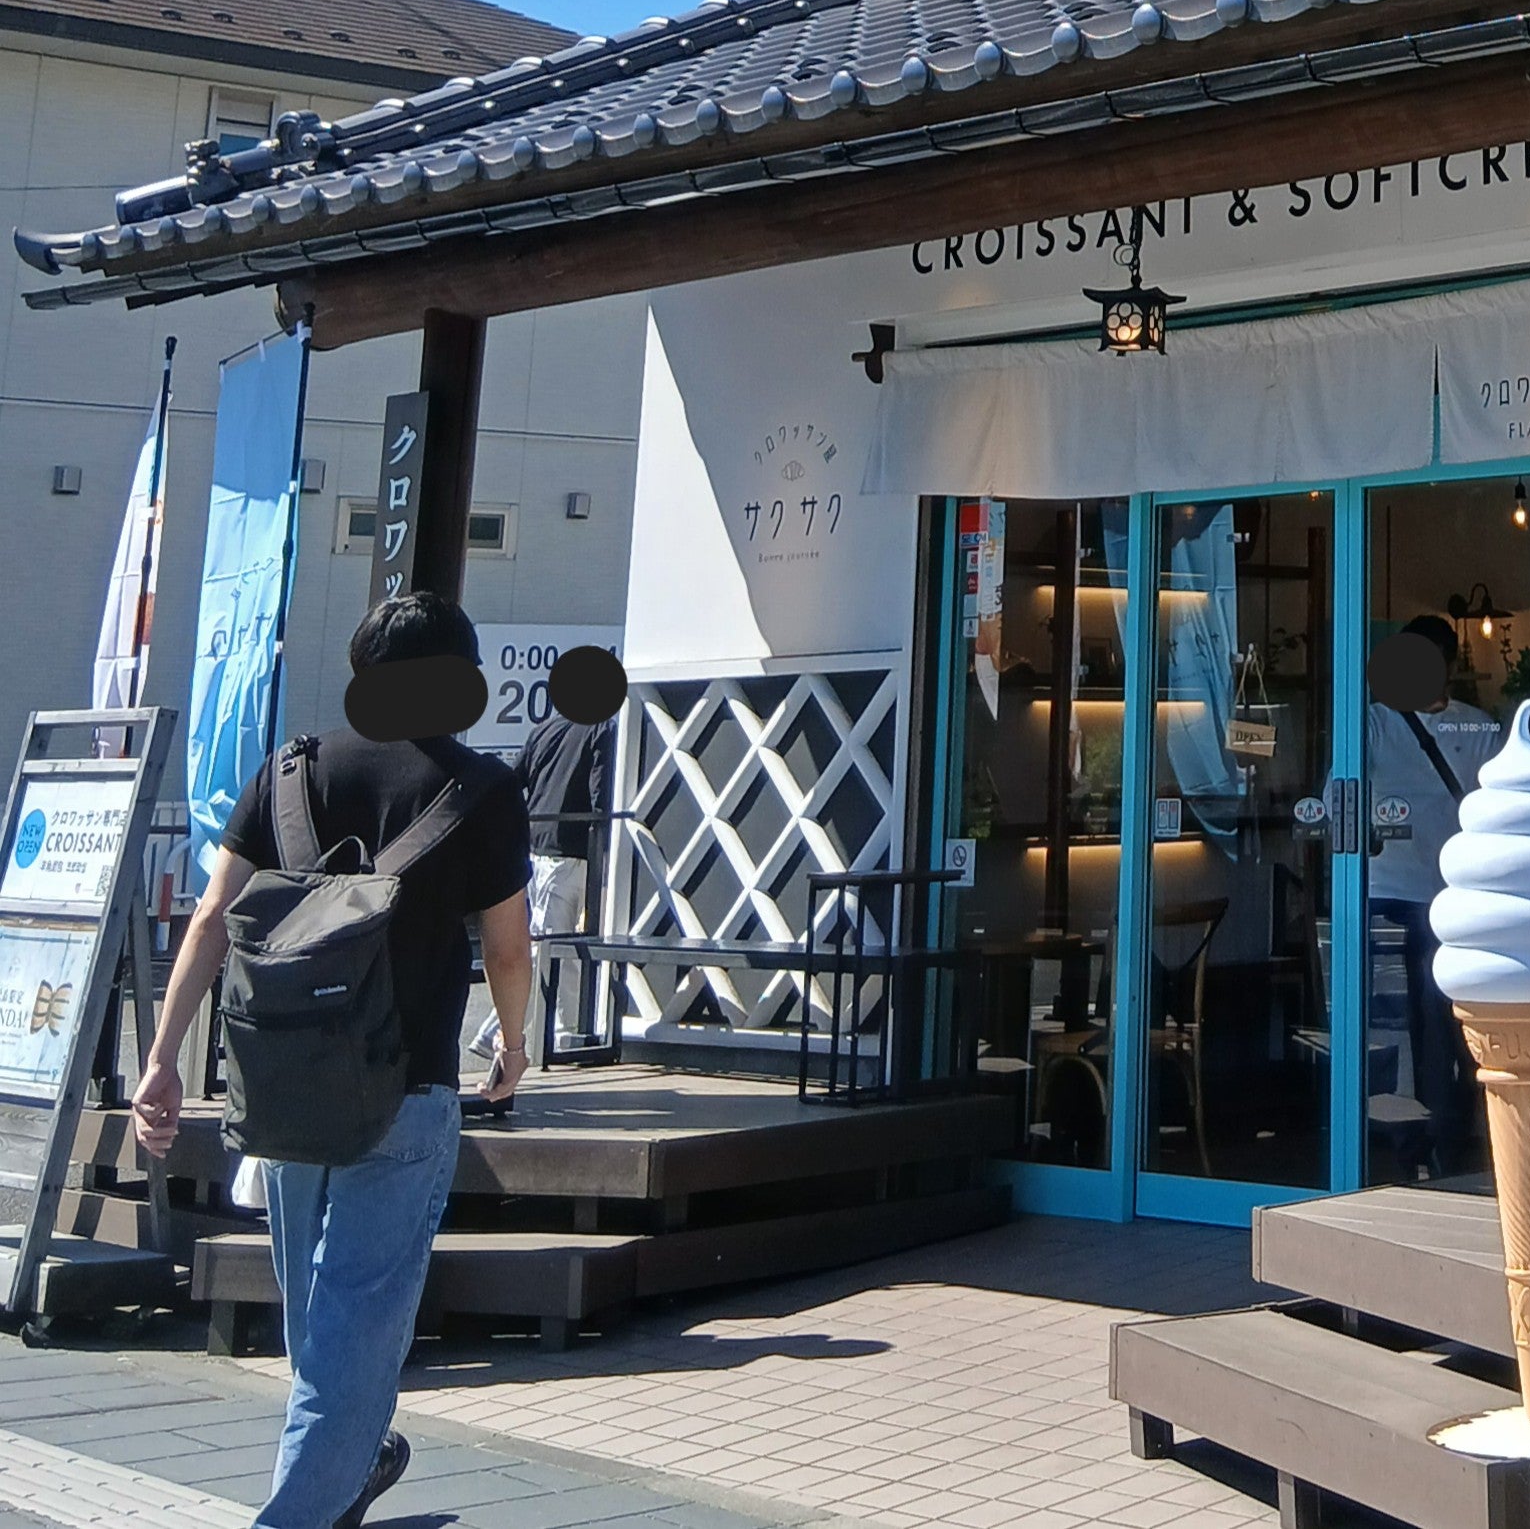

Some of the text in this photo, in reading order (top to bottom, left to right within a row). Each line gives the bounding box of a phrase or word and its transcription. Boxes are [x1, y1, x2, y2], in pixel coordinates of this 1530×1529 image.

[911, 196, 1194, 274] CROISSANT
[1228, 187, 1259, 227] &
[754, 424, 837, 464] クロワッサン屋
[384, 425, 417, 601] クロワッ
[744, 493, 841, 542] サクサク
[46, 832, 122, 853] CROISSANT
